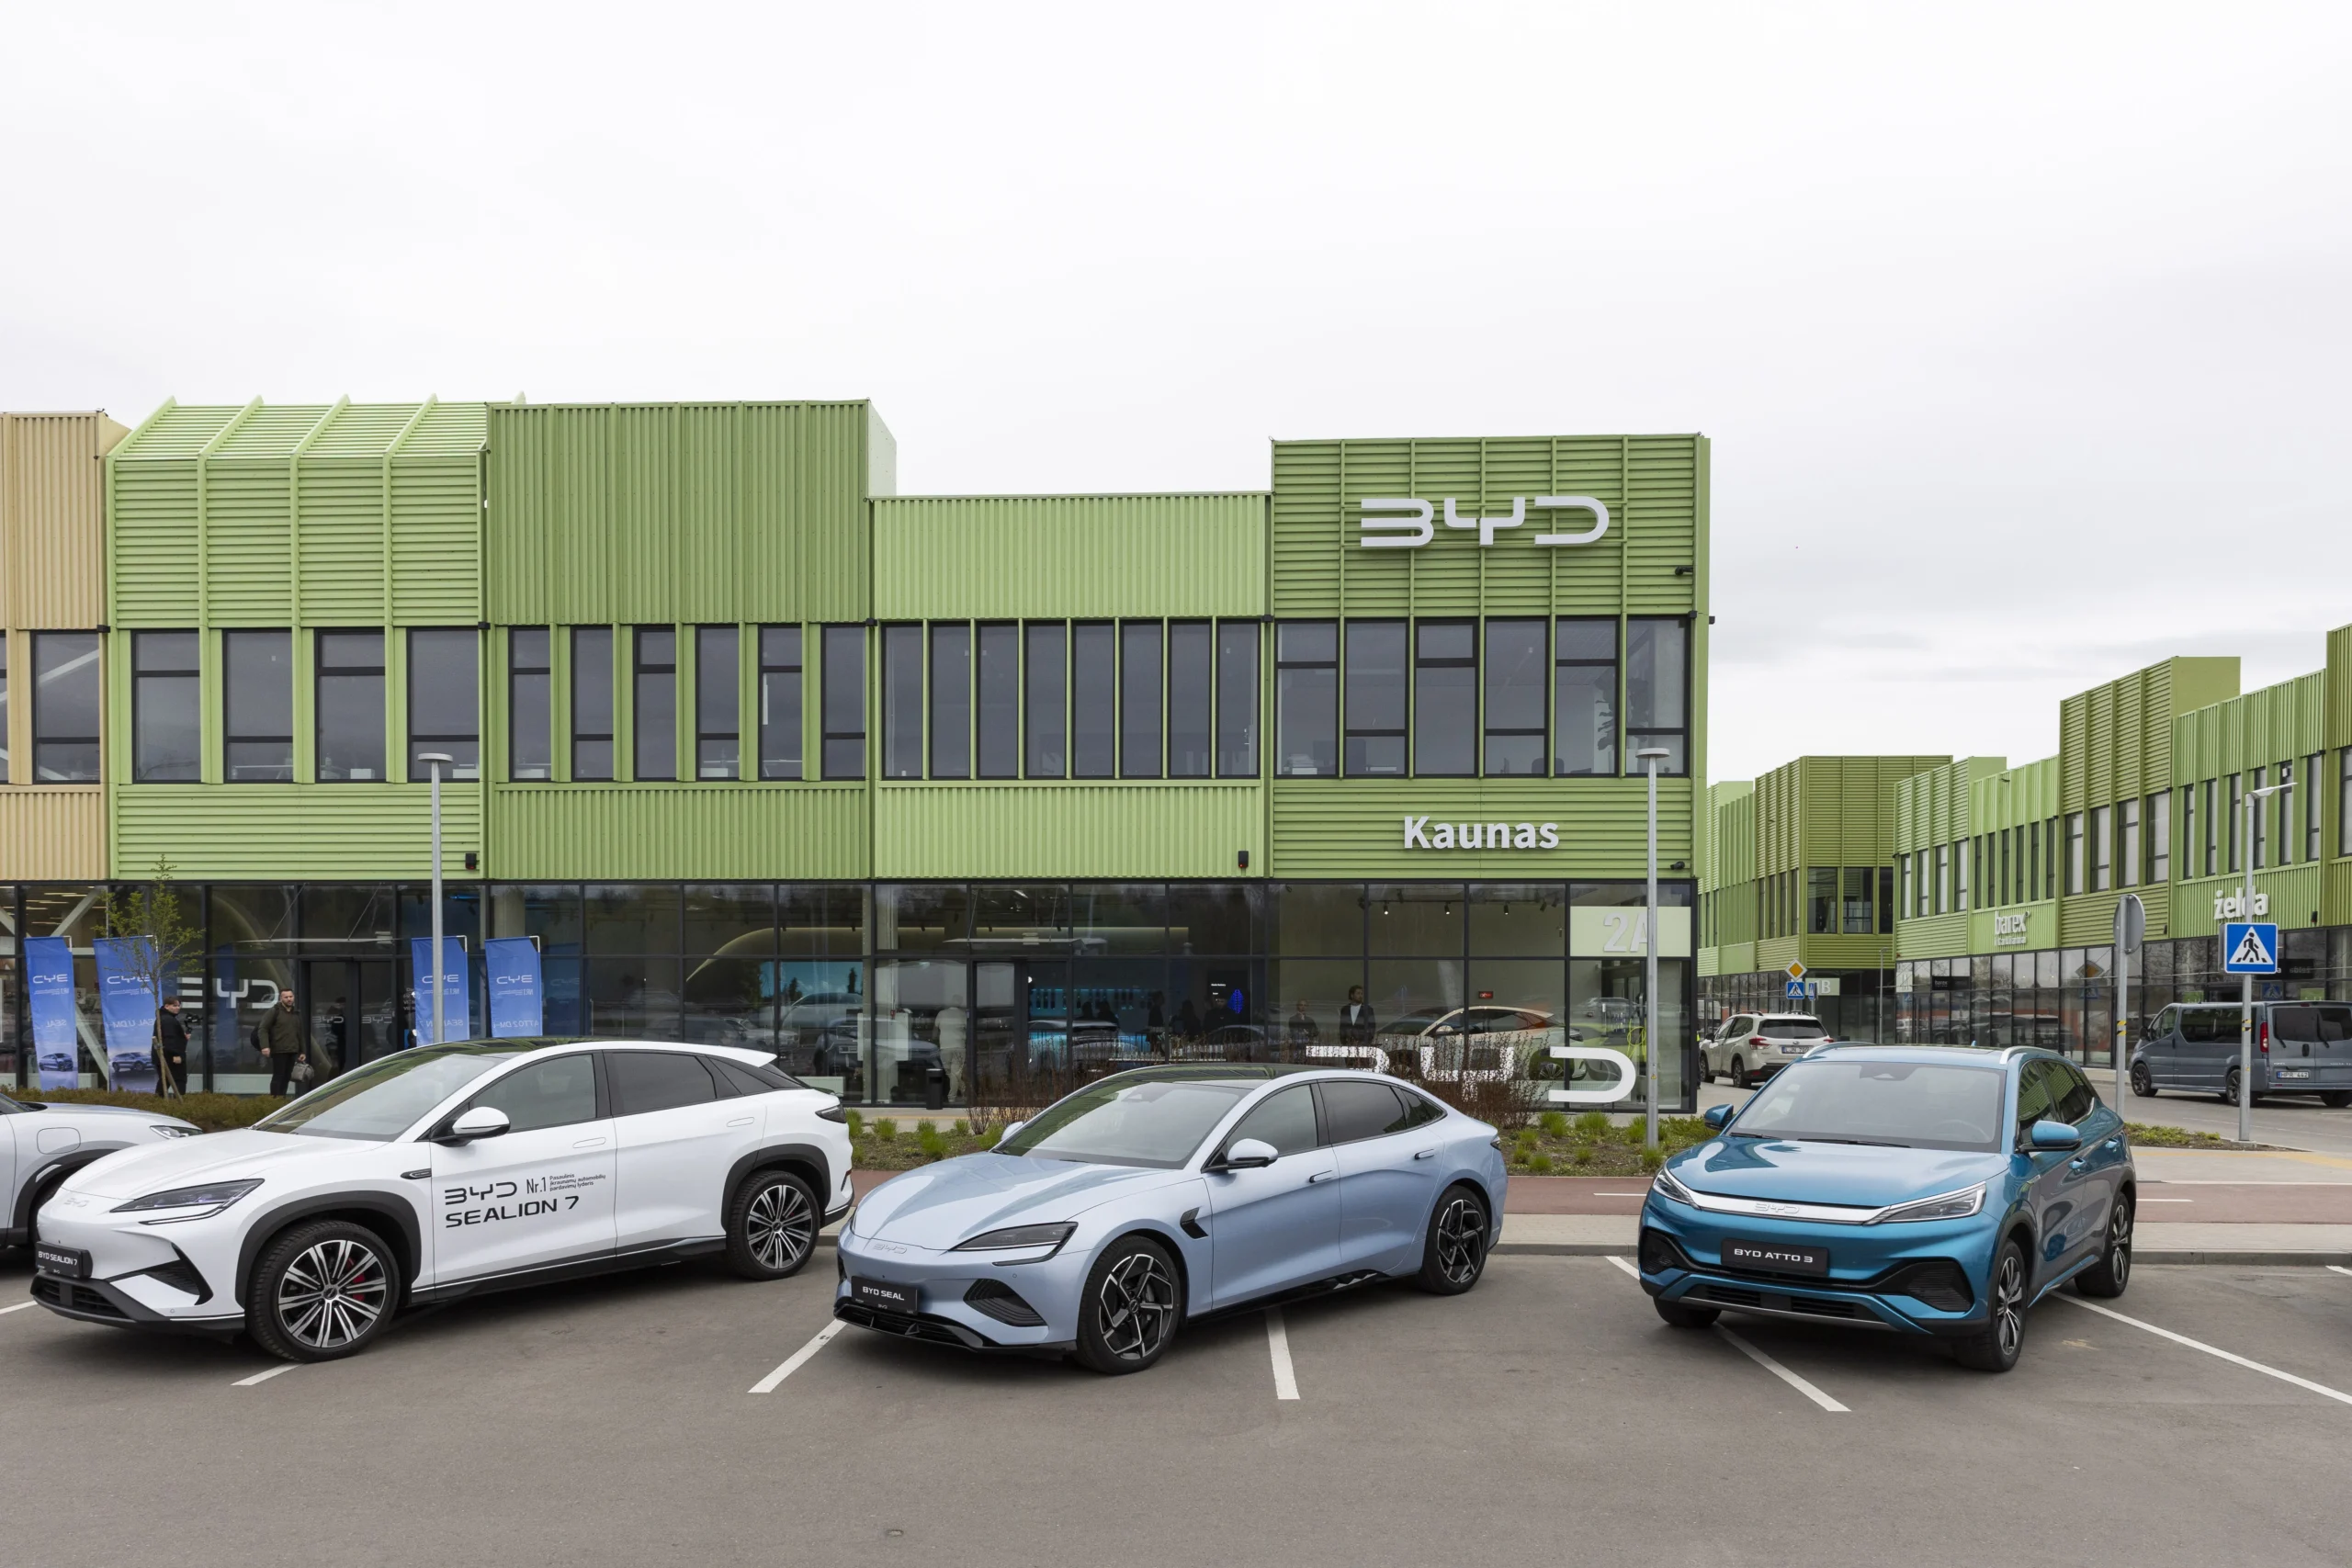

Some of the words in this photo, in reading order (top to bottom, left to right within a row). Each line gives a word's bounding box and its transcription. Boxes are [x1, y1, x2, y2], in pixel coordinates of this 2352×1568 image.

[1361, 495, 1610, 548] BYD
[1404, 815, 1560, 850] Kaunas
[1603, 910, 1648, 953] 2A
[1995, 911, 2027, 935] barex
[312, 1015, 345, 1024] BYD
[444, 1181, 518, 1205] BYD
[526, 1177, 547, 1194] Nr.1
[446, 1198, 558, 1228] SEALION
[564, 1195, 580, 1210] 7
[1754, 1201, 1800, 1214] BYD
[38, 1250, 50, 1260] BYD
[50, 1253, 74, 1265] SEALION
[872, 1243, 908, 1255] BYD
[1734, 1247, 1762, 1258] BYD
[1764, 1251, 1801, 1262] ATTO
[862, 1286, 879, 1296] BYD
[880, 1290, 905, 1301] SEAL
